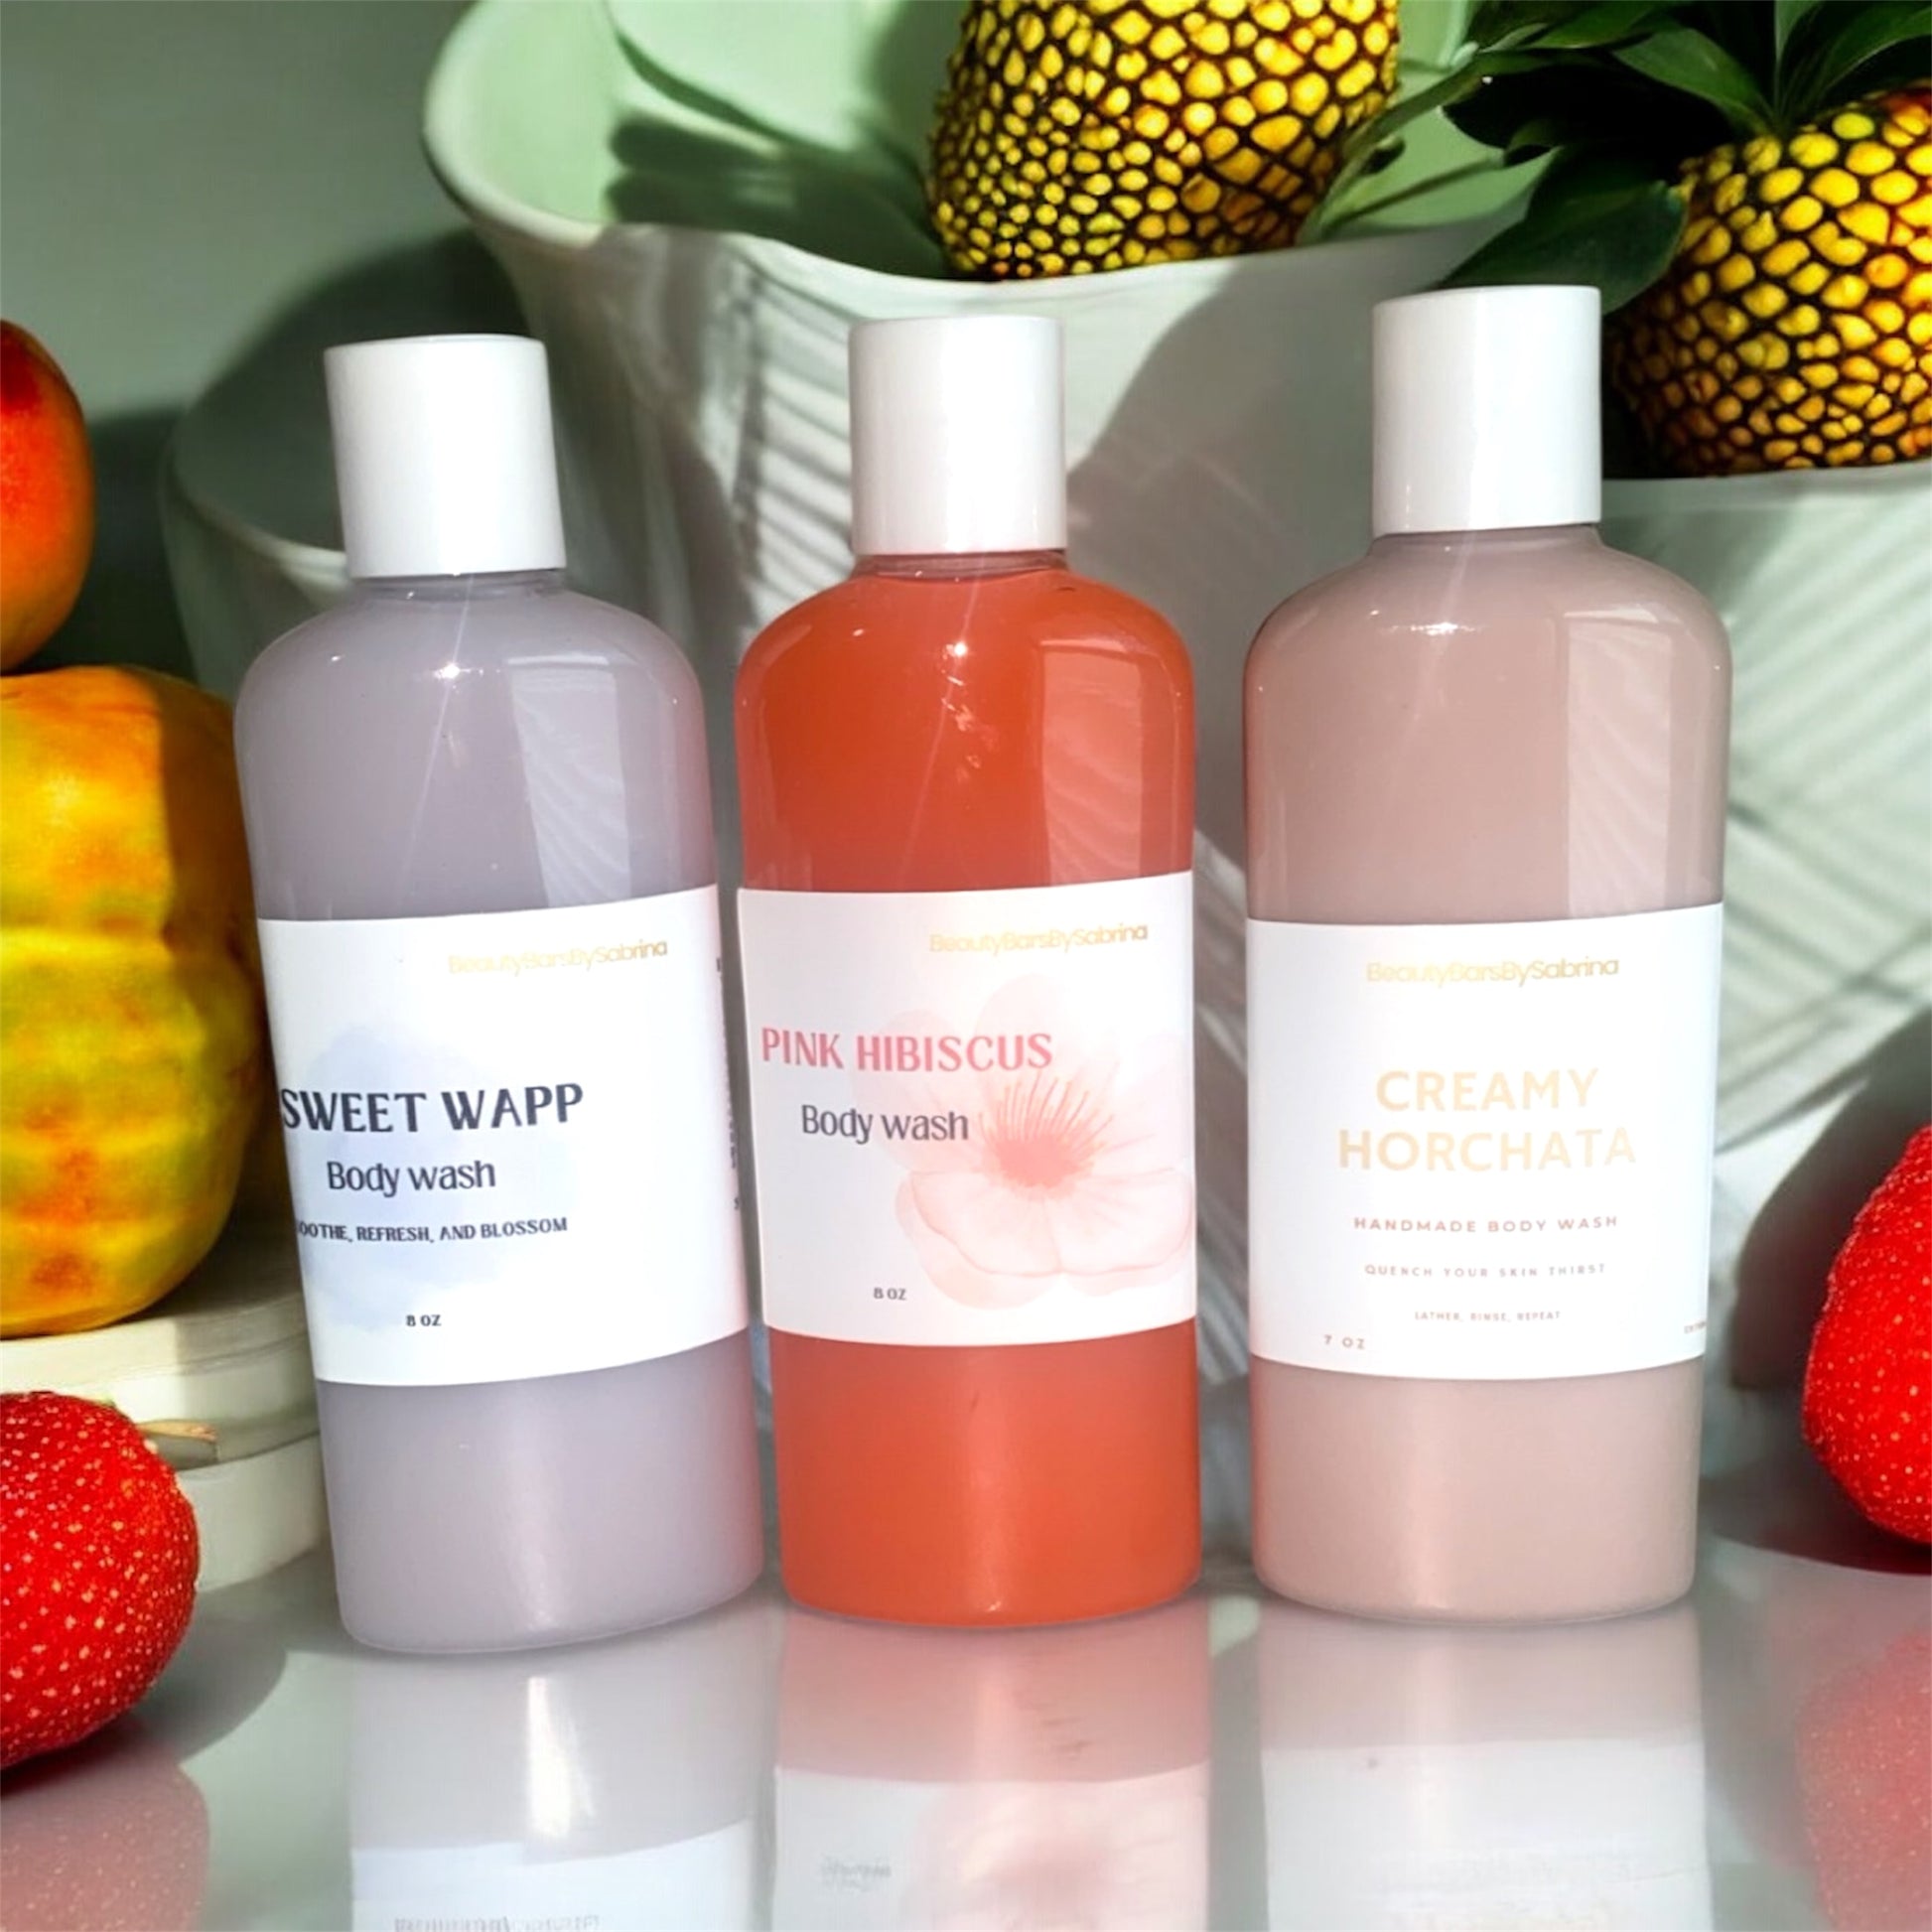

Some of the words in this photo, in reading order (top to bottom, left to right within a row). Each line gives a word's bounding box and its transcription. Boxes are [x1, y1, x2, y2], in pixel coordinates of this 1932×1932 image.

[929, 922, 1149, 956] BeautyBarsBySabrina
[1366, 956, 1619, 988] BeautyBarsBySabrina
[761, 1027, 844, 1068] PINK
[857, 1033, 1052, 1072] HIBISCUS
[1375, 1068, 1599, 1112] CREAMY
[281, 1088, 427, 1132] SWEET
[441, 1083, 584, 1131] WAPP
[801, 1104, 873, 1145] Body
[882, 1111, 969, 1141] wash
[1338, 1126, 1637, 1172] HORCHATA
[327, 1162, 399, 1198] Body
[407, 1160, 496, 1190] wash
[299, 1220, 353, 1243] OOTHE,
[356, 1226, 435, 1243] REFRESH,
[440, 1223, 476, 1241] AND
[481, 1217, 568, 1238] BLOSSOM
[1353, 1217, 1477, 1233] HANDMADE
[1487, 1219, 1547, 1233] BODY
[1557, 1215, 1618, 1231] WASH
[1364, 1264, 1433, 1278] QUENCH
[1444, 1267, 1488, 1278] YOUR
[1498, 1266, 1538, 1278] SKIN
[1548, 1264, 1605, 1277] THIRST
[873, 1287, 885, 1300] 8
[405, 1314, 417, 1327] 8
[419, 1314, 442, 1327] OZ
[1323, 1334, 1332, 1345] 7
[1341, 1337, 1366, 1350] OZ
